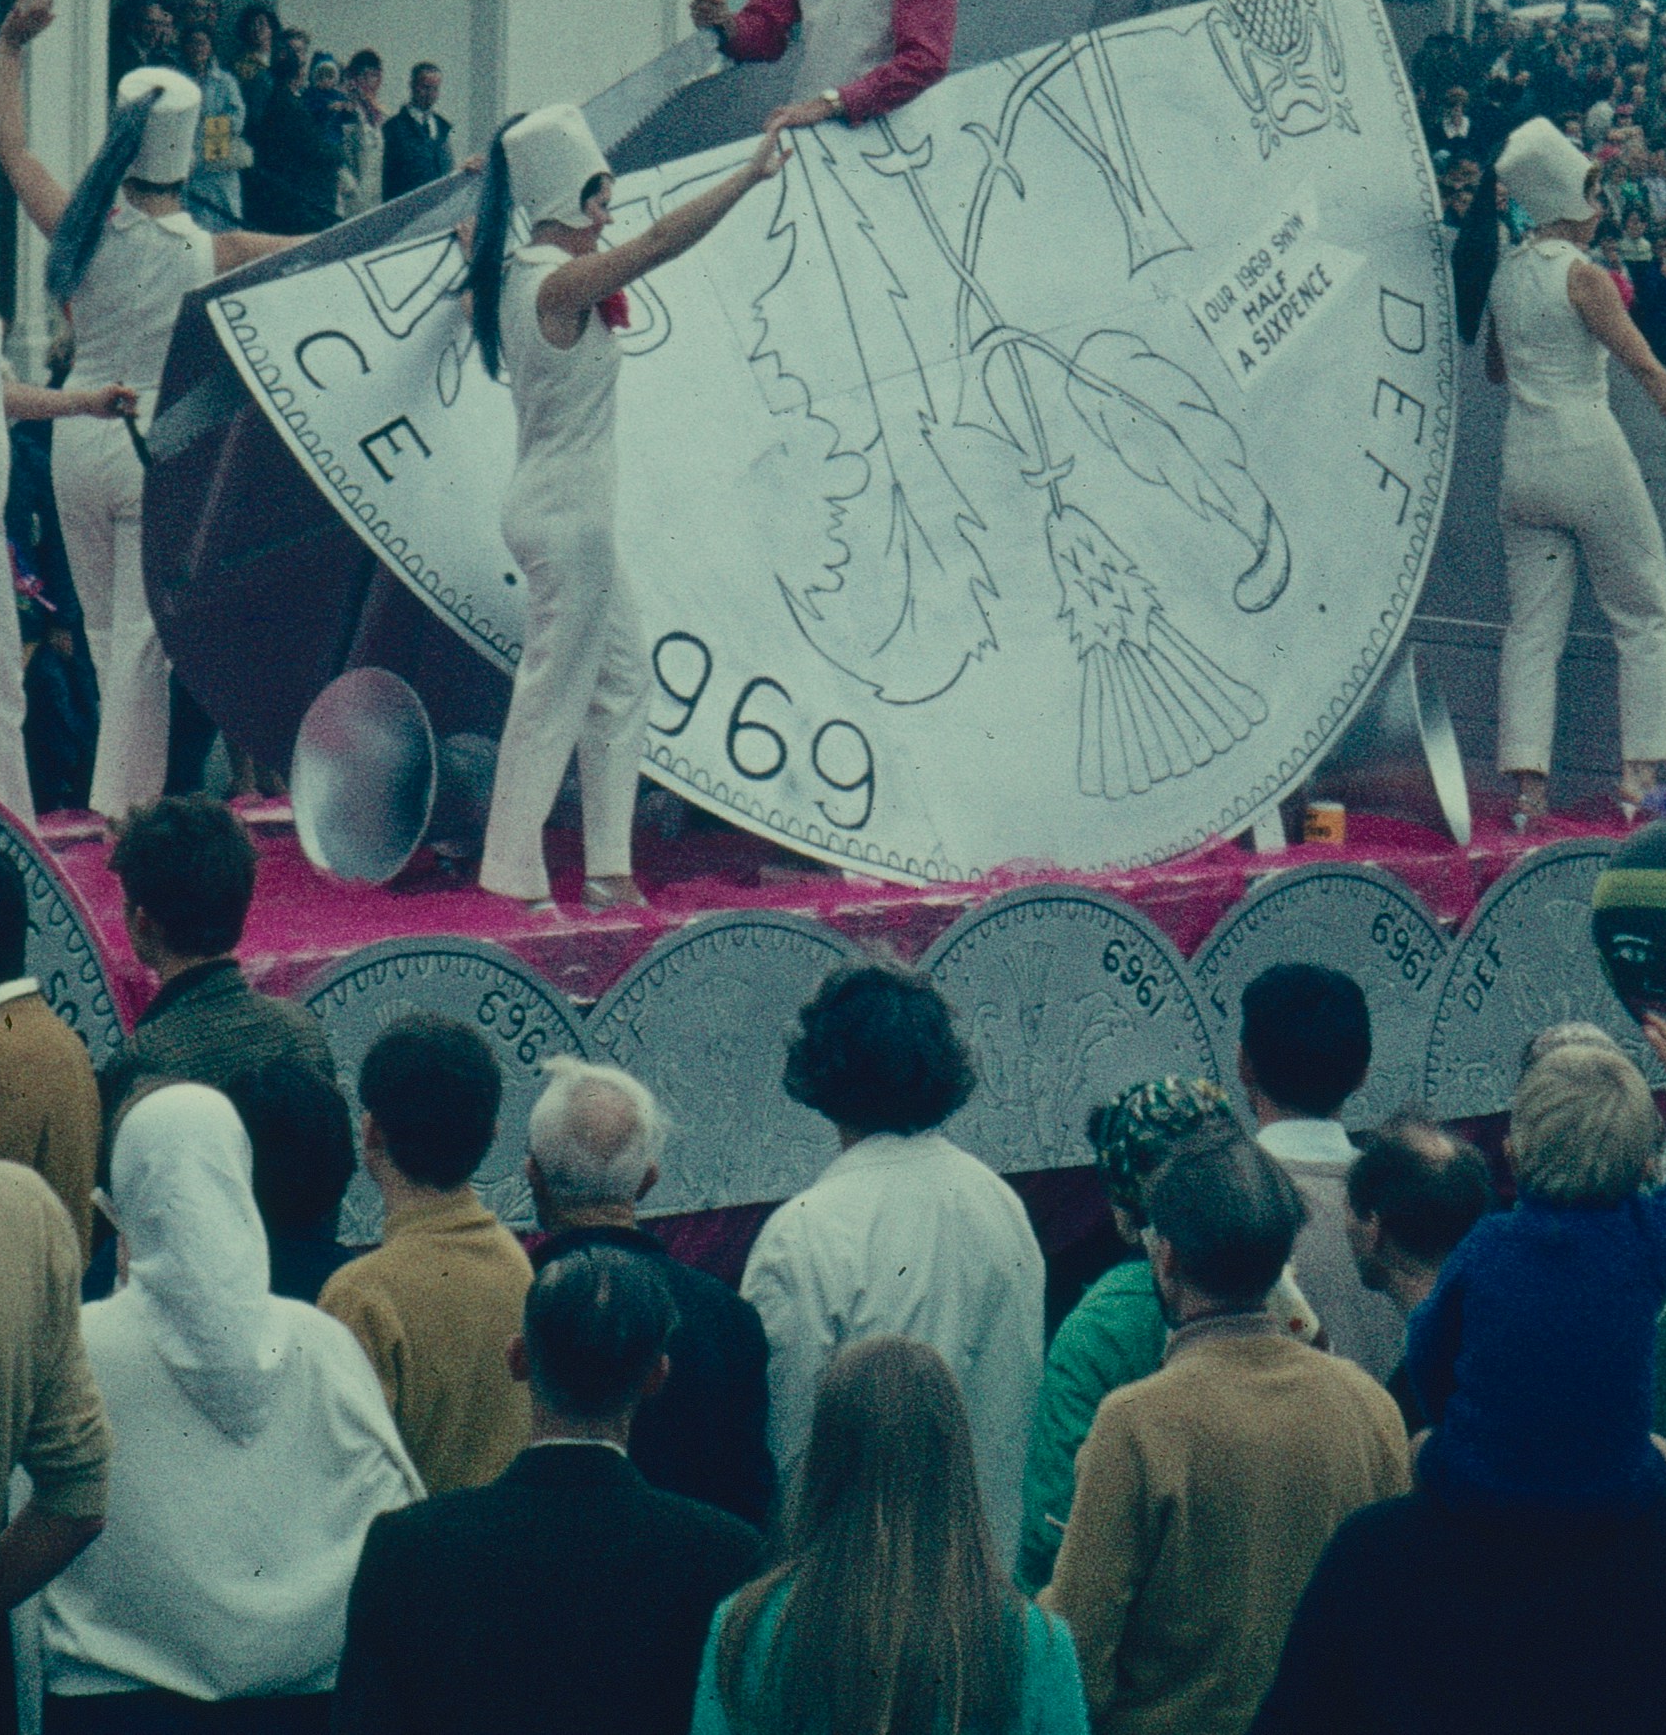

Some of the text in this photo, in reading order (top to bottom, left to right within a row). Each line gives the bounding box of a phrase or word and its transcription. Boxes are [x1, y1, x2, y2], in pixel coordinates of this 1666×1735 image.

[1203, 210, 1305, 324] OUR 1969 SHOW
[1237, 261, 1333, 374] A SIXPENCE
[1241, 268, 1288, 326] HALF
[648, 630, 875, 831] 969
